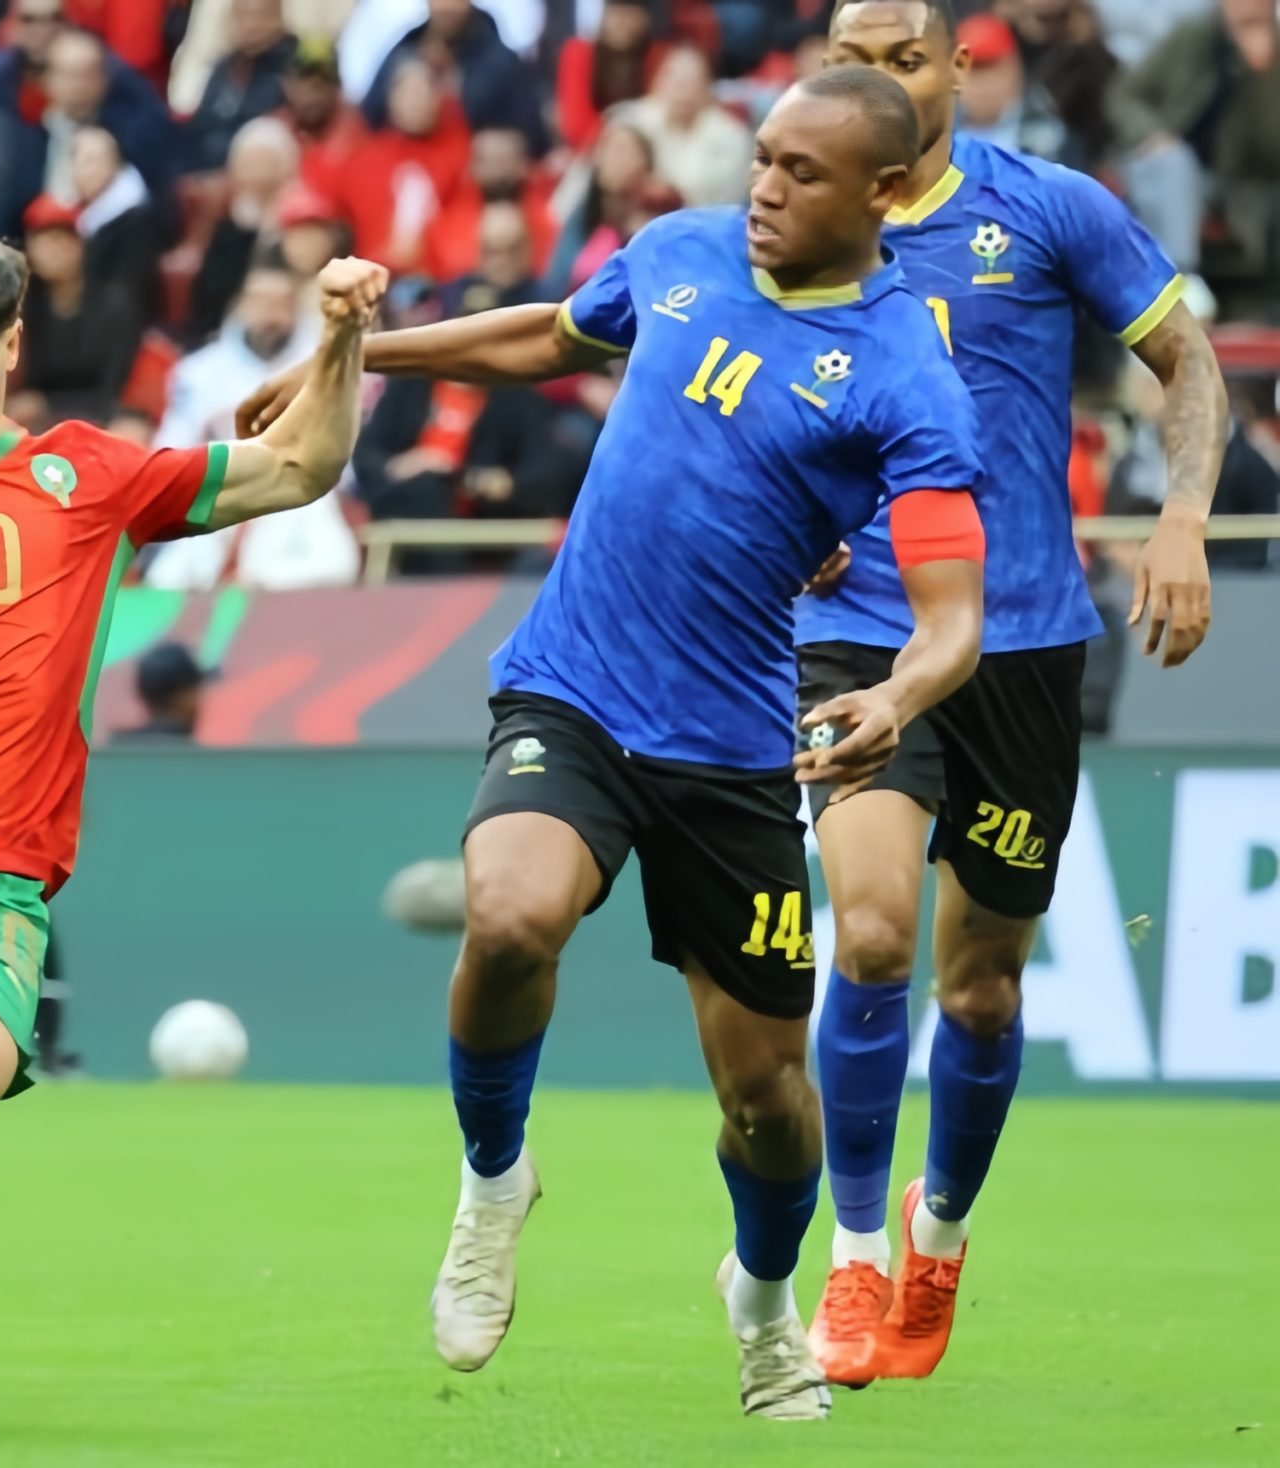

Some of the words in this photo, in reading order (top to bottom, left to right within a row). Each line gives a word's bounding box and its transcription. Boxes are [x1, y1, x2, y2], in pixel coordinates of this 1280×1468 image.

[683, 336, 763, 417] 14
[966, 800, 1032, 858] 20
[741, 890, 803, 960] 14
